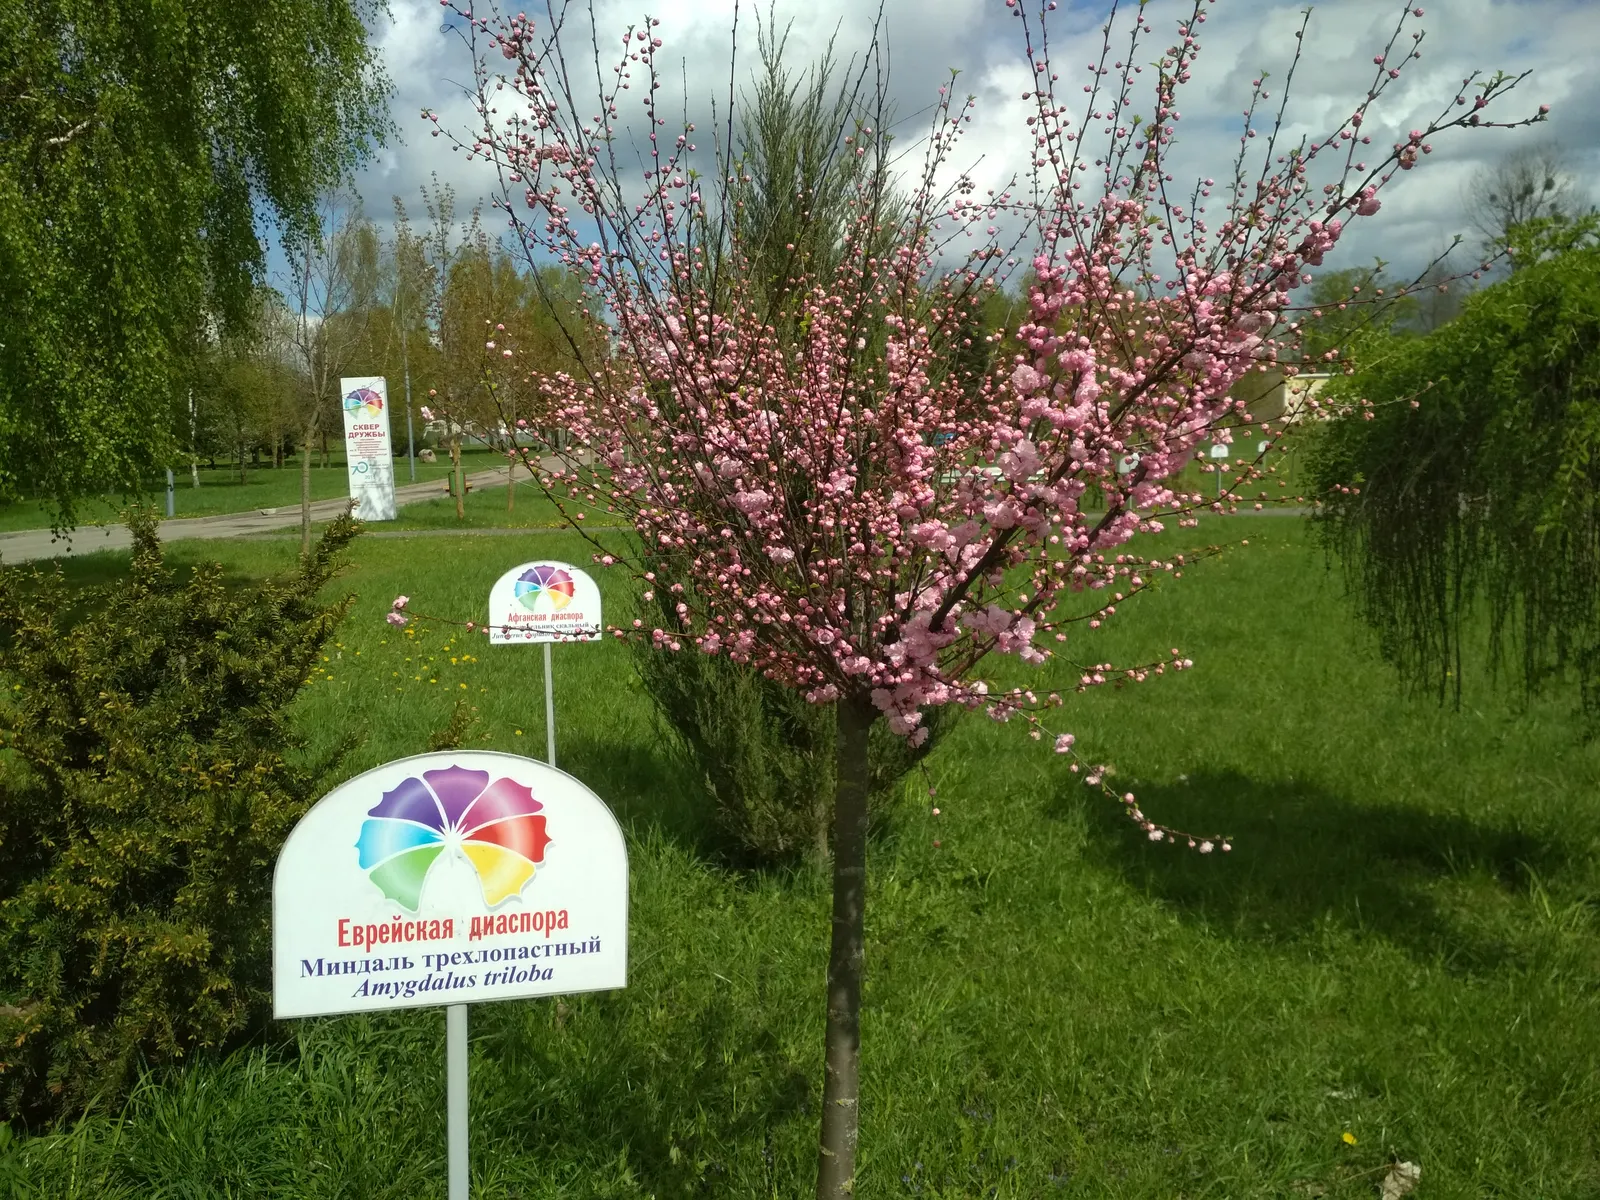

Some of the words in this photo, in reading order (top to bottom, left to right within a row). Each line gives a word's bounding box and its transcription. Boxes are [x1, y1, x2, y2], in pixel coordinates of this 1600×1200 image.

[348, 431, 386, 439] ДРУЖБЫ
[508, 613, 547, 624] Афганская
[551, 612, 584, 622] диаспора
[338, 915, 454, 953] Еврейская
[469, 909, 569, 942] диаспора
[300, 957, 415, 978] Миндаль
[422, 936, 602, 971] трехлопастный
[351, 970, 477, 999] Amygdalus
[484, 963, 554, 986] triloba
